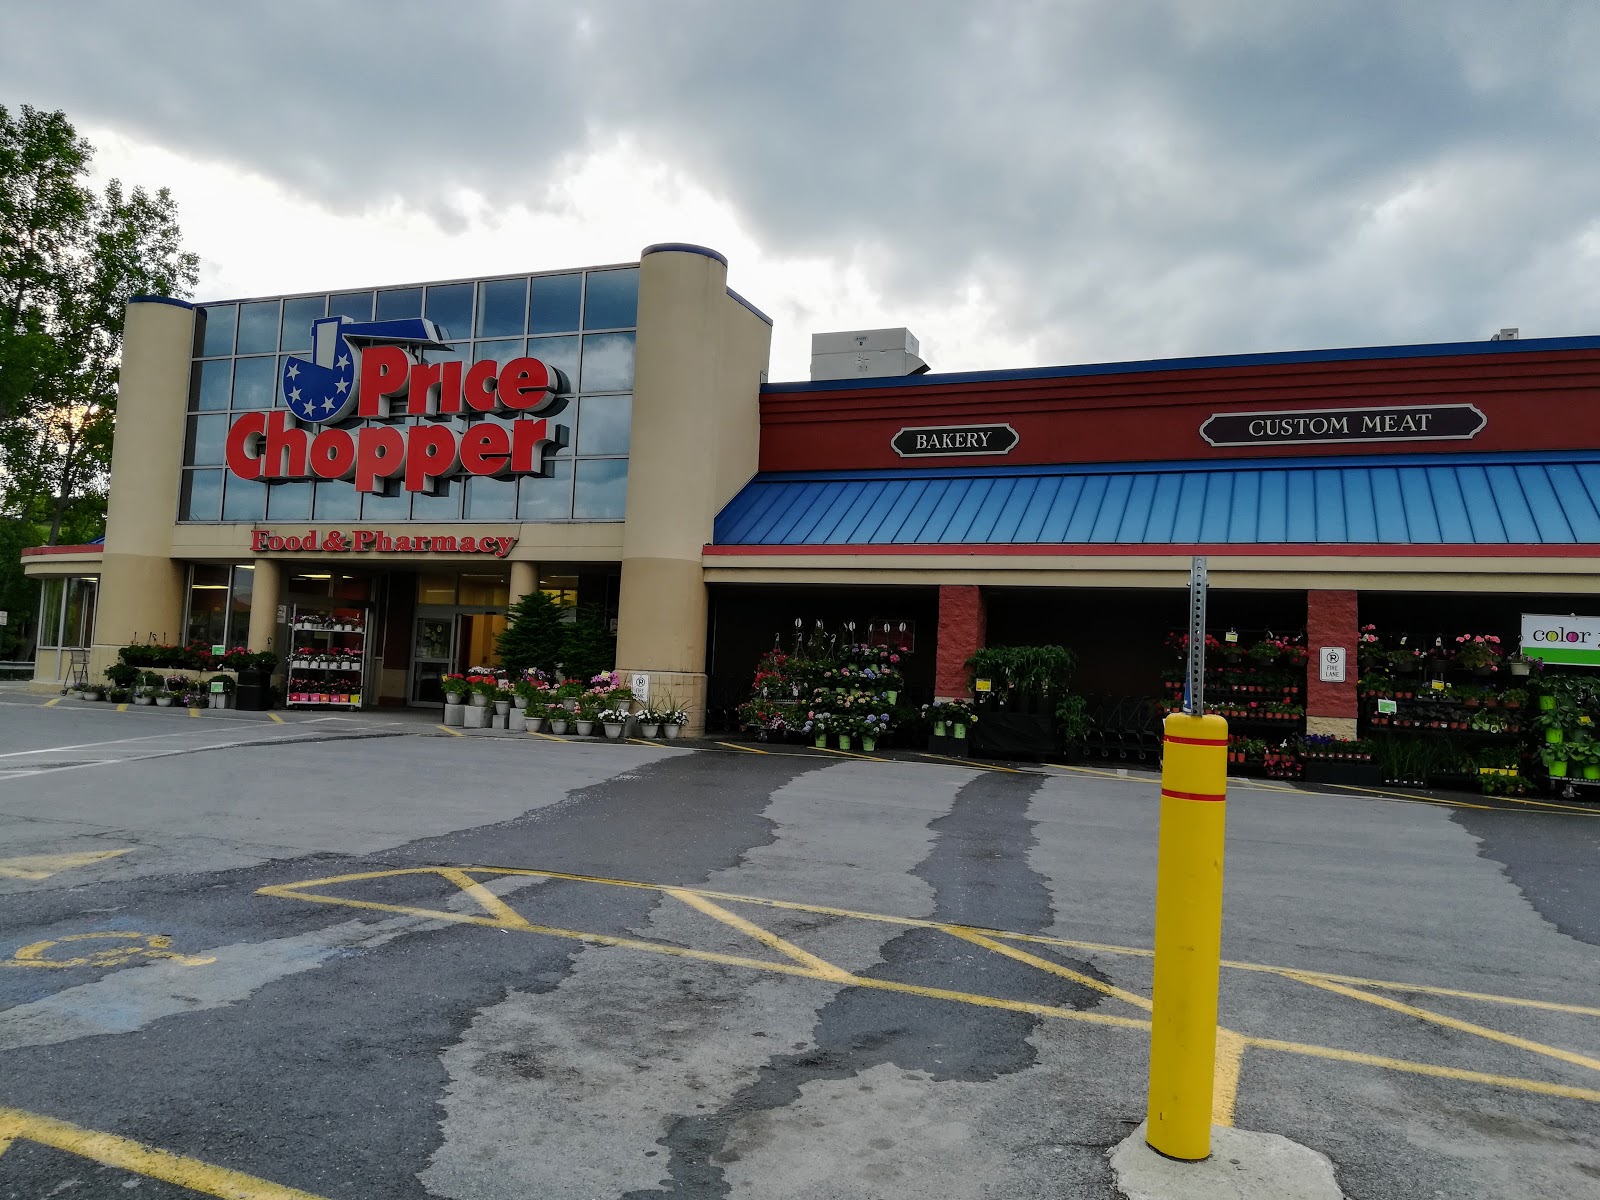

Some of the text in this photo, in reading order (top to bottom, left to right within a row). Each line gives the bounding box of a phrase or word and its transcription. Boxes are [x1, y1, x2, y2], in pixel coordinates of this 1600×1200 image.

[358, 346, 548, 417] Price
[1248, 412, 1432, 437] CUSTOM MEAT
[226, 411, 548, 492] Chopper
[915, 431, 992, 450] BAKERY
[251, 530, 515, 558] Food & Pharmacy
[1533, 626, 1592, 643] color
